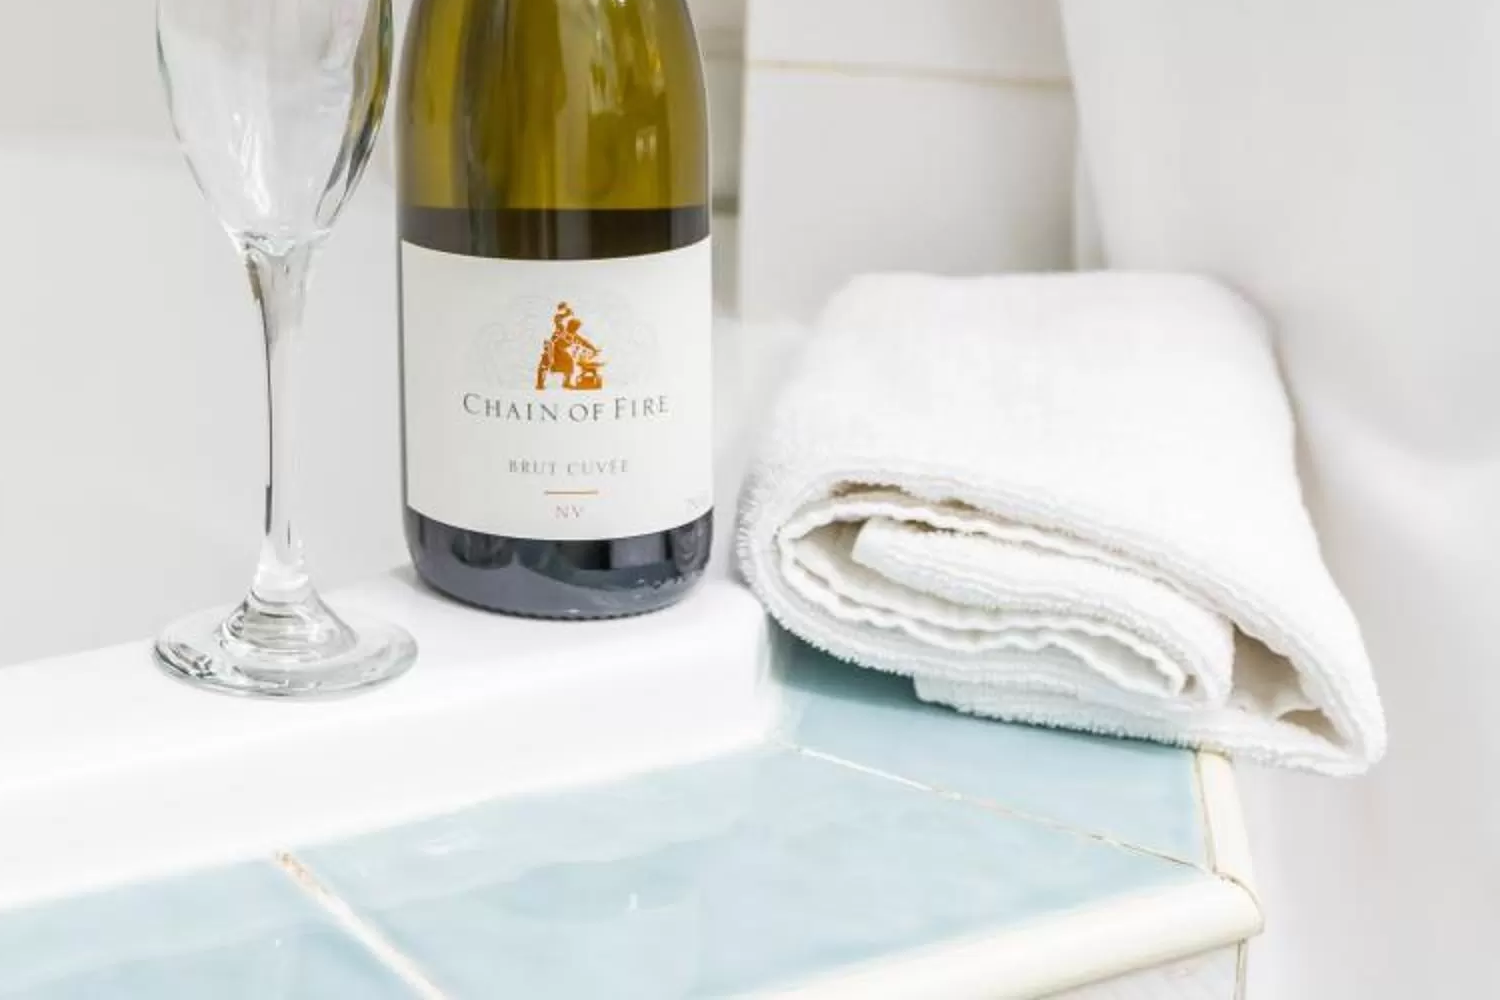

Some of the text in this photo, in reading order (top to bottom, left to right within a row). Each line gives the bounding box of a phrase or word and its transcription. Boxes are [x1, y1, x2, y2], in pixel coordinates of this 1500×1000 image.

[462, 393, 670, 422] CHAIN OF FIRE
[509, 459, 556, 476] BRUT
[555, 504, 584, 519] NV
